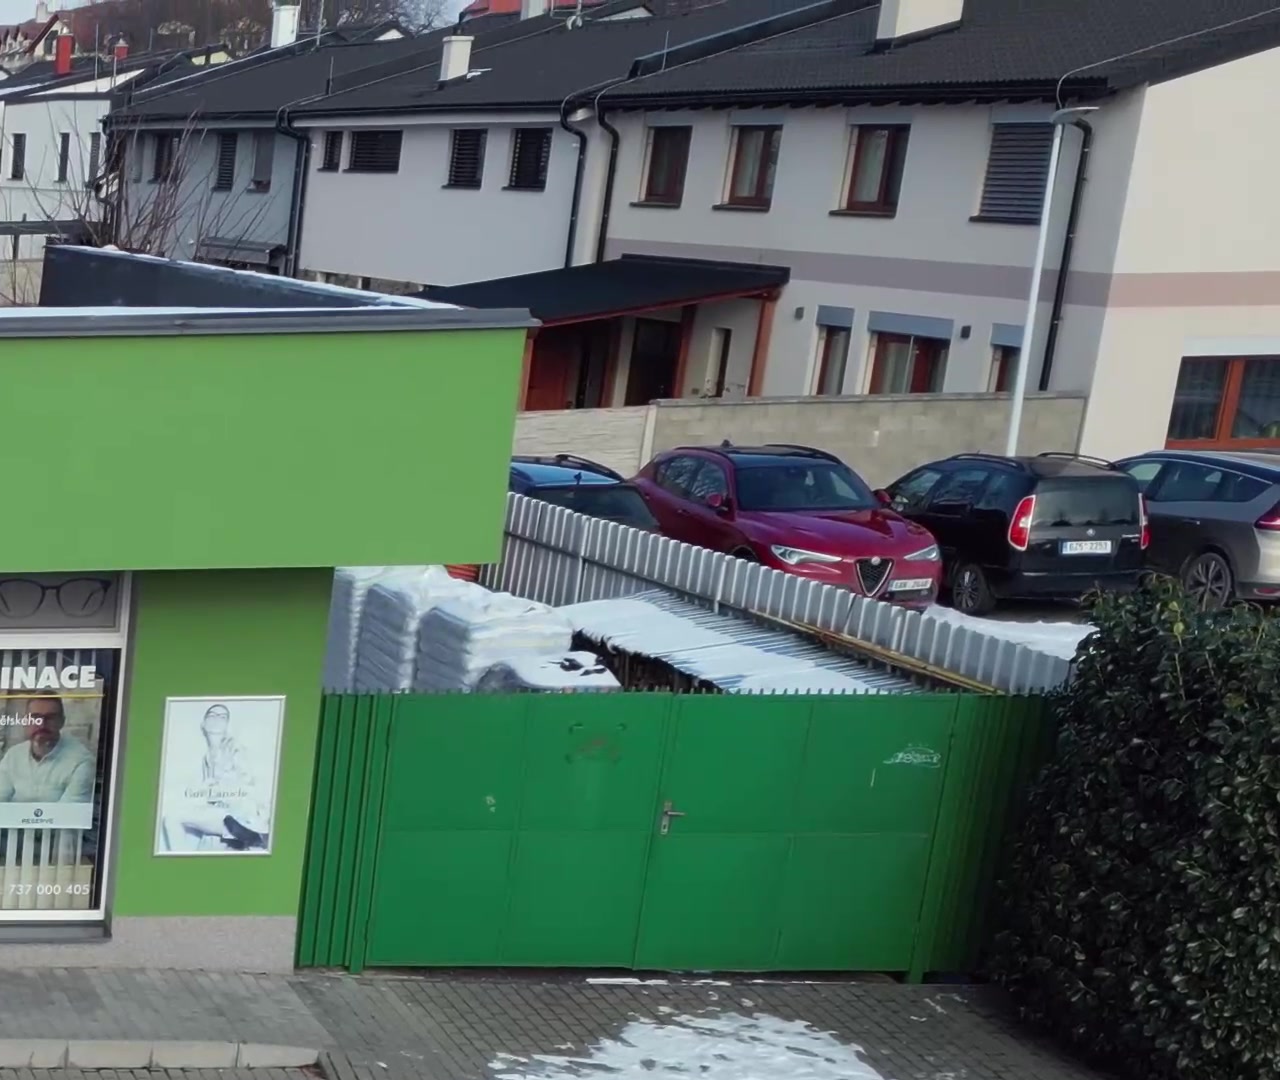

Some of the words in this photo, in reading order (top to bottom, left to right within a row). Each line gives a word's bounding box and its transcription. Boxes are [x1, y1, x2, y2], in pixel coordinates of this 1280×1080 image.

[9, 884, 32, 895] 737
[36, 884, 61, 895] 000
[65, 884, 90, 895] 405
